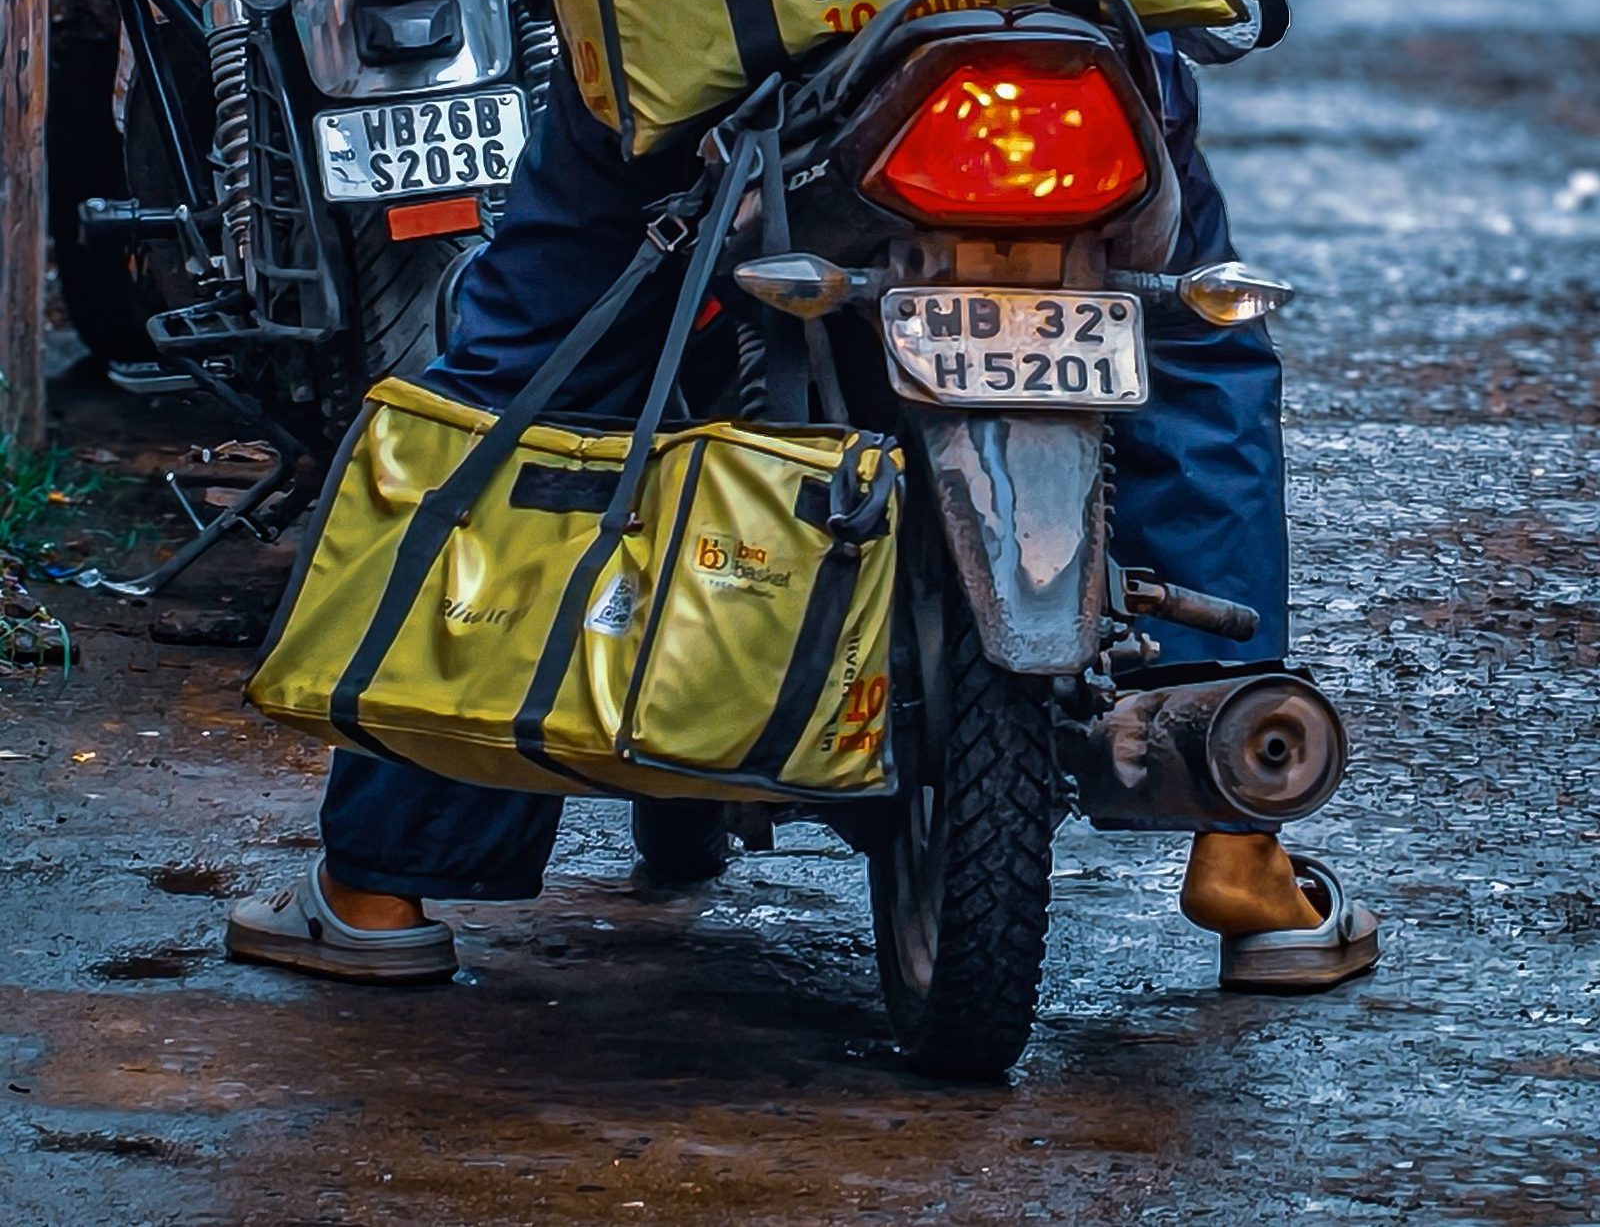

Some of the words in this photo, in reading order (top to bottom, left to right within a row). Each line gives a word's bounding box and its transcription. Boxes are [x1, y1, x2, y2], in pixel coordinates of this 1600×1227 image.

[823, 1, 879, 33] 10
[362, 96, 502, 152] WB26B
[369, 139, 509, 193] S2036
[924, 297, 1001, 339] WB
[1035, 299, 1104, 344] 32
[934, 352, 967, 390] H
[983, 351, 1114, 395] 5201
[845, 675, 888, 722] 10
